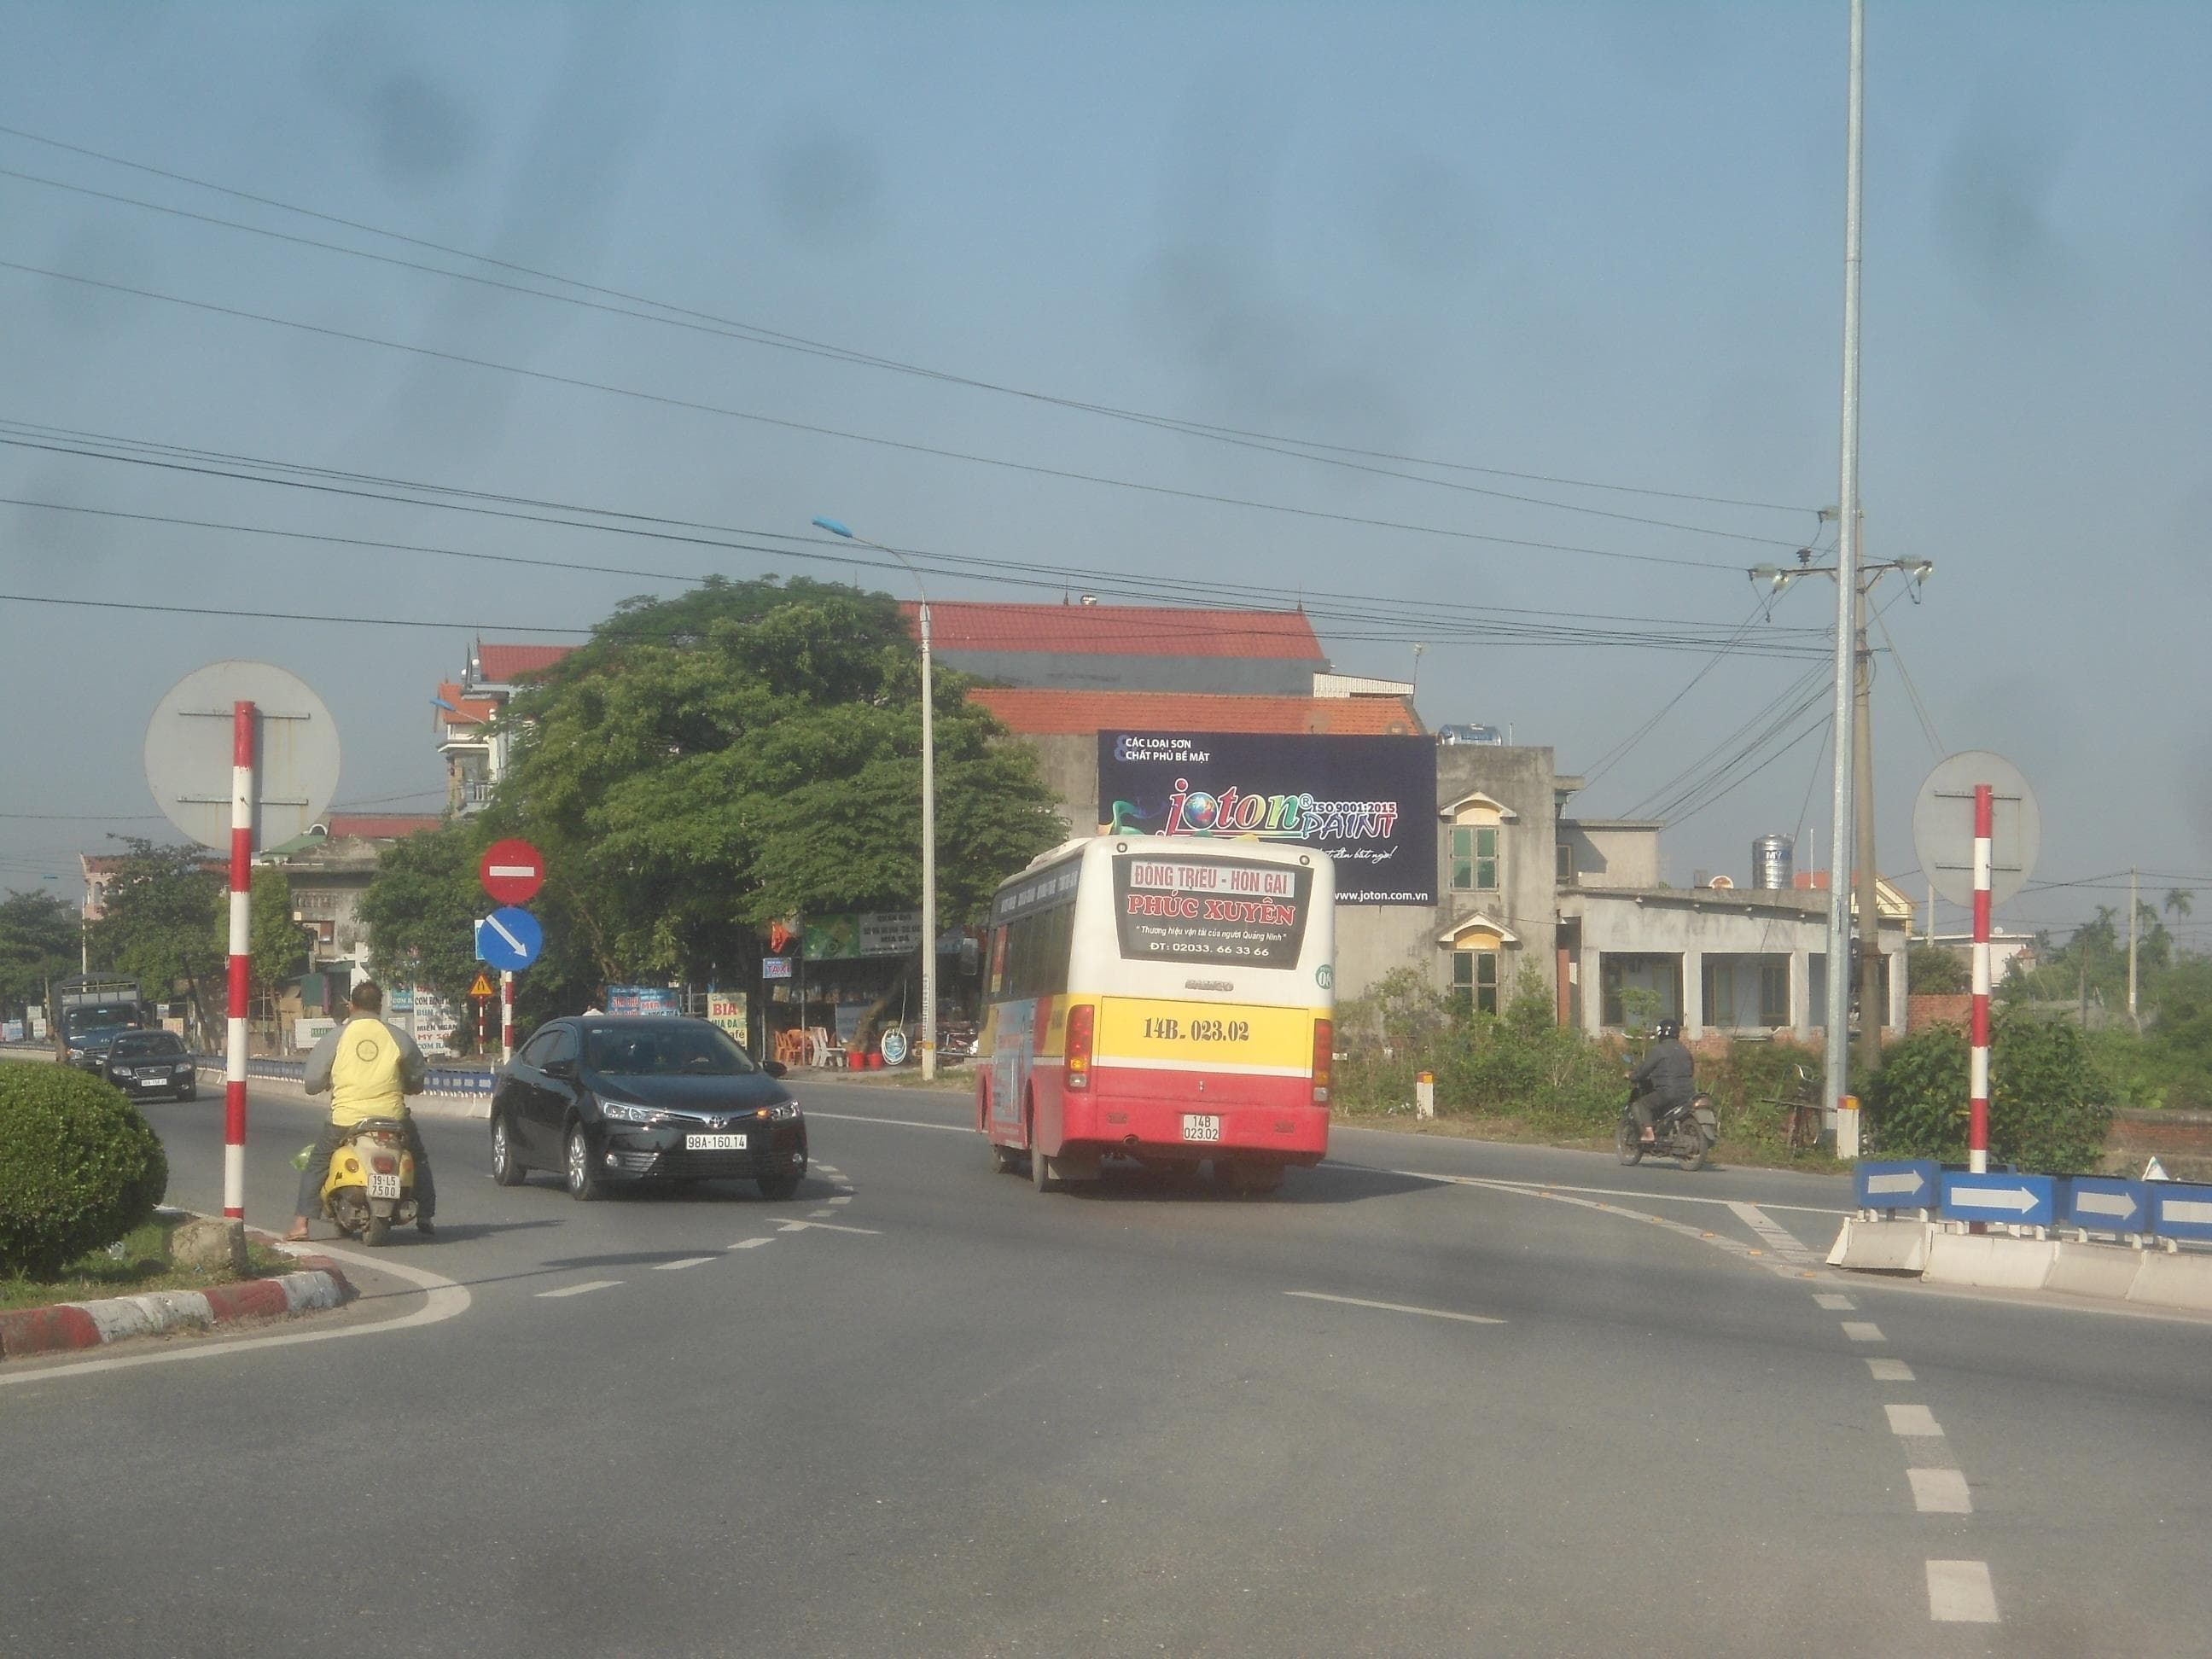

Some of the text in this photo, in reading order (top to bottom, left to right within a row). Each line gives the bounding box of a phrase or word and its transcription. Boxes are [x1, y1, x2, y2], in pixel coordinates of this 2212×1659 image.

[1126, 737, 1191, 750] CÁC LOẠI SƠN
[1126, 748, 1151, 760] CHẤT
[1153, 750, 1173, 761] PHỦ
[1189, 752, 1210, 764] MẶT
[1313, 802, 1334, 813] ISO
[1301, 812, 1399, 840] PAINT
[1265, 873, 1288, 894] GAI
[1127, 889, 1296, 927] PHÚC XUYÊN
[1217, 946, 1232, 954] 66
[1236, 946, 1250, 955] 33
[1254, 947, 1269, 956] 66
[713, 1003, 738, 1016] BIA
[1190, 1019, 1249, 1041] 023.02
[1193, 1115, 1211, 1128] 14B
[1185, 1127, 1219, 1140] 023.02
[688, 1136, 745, 1148] 98A-160.14
[372, 1185, 396, 1196] 7500
